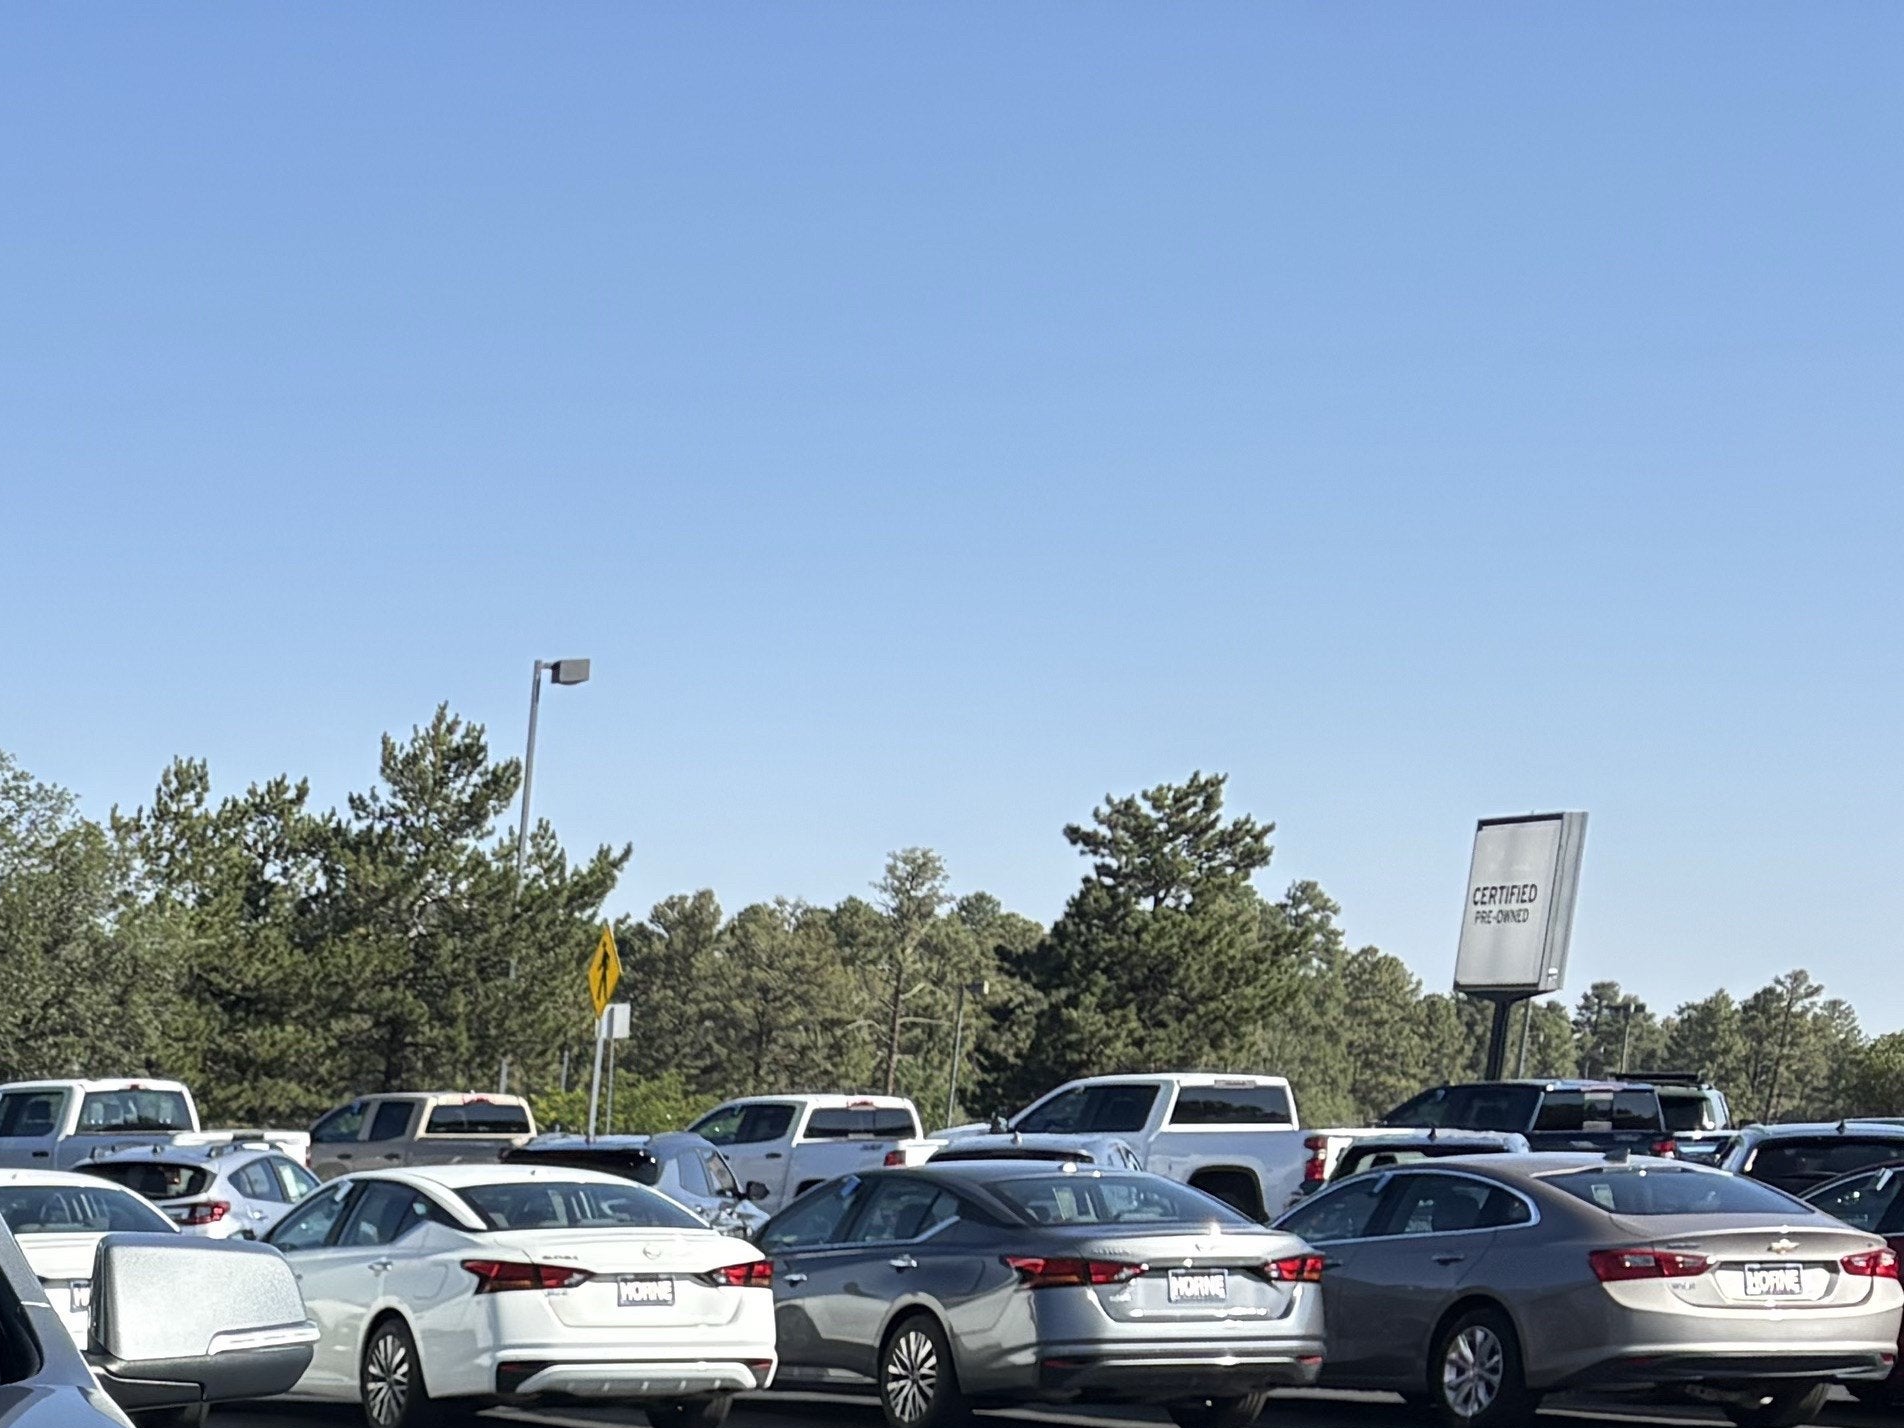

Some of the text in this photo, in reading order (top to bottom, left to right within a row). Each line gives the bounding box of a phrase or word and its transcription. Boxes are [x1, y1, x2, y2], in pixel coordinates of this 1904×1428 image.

[1473, 884, 1537, 906] CERTIFIED
[1474, 909, 1529, 924] PRE-OWNED
[619, 1280, 673, 1301] HORNE
[1171, 1275, 1226, 1298] HORNE
[1749, 1269, 1800, 1292] HORNE
